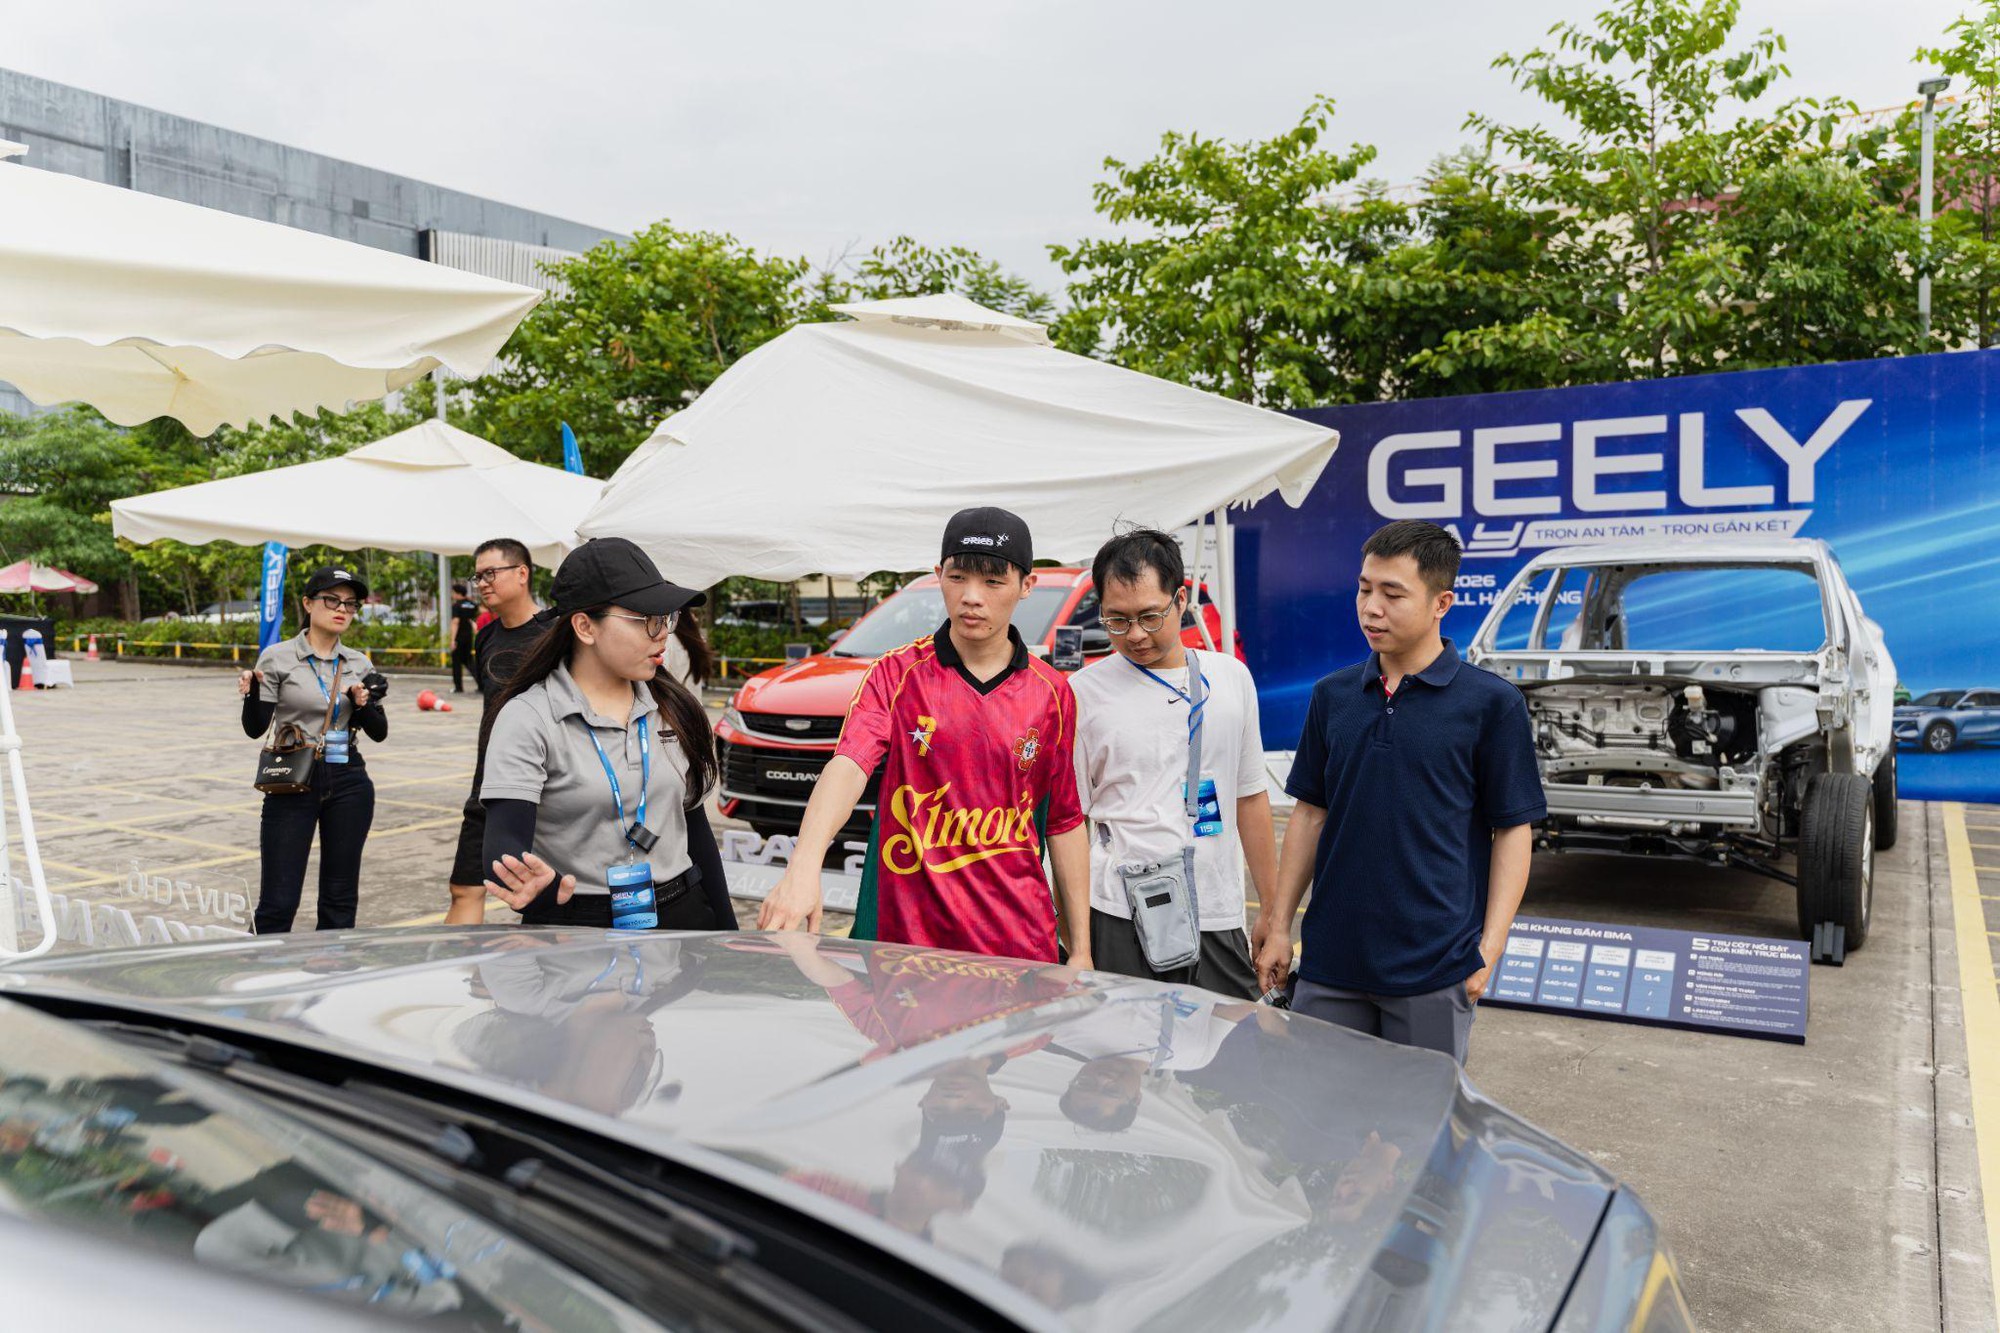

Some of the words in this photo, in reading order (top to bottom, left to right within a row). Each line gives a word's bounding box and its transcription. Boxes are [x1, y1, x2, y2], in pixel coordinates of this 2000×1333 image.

[1367, 398, 1873, 520] GEELY
[1582, 525, 1605, 539] AN
[1609, 522, 1645, 537] TÂM
[265, 550, 284, 622] GEELY
[1454, 592, 1476, 606] LL
[917, 715, 937, 757] 7
[766, 770, 820, 781] COOLRAY
[1509, 922, 1529, 931] NG
[1530, 924, 1572, 935] KHUNG
[1604, 931, 1632, 941] BMA
[1691, 938, 1710, 951] 5
[1644, 974, 1661, 983] 0.4
